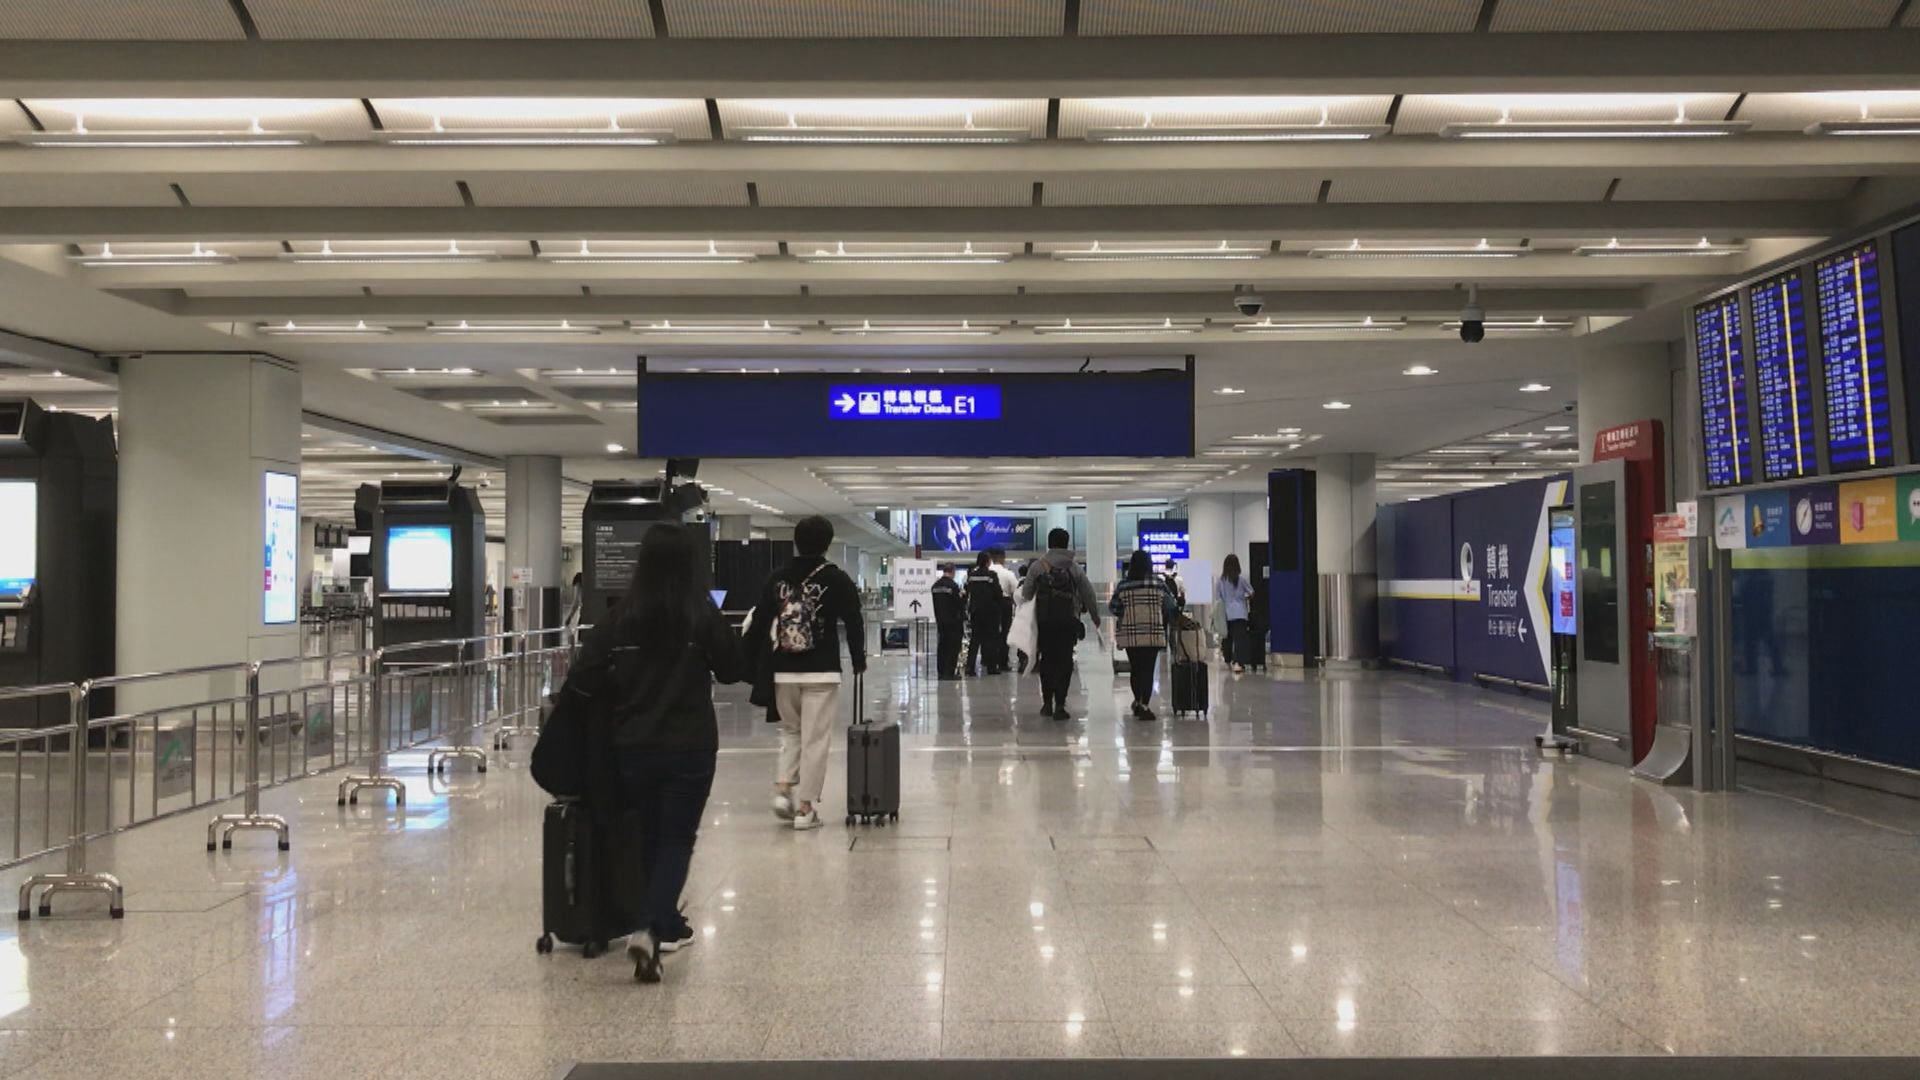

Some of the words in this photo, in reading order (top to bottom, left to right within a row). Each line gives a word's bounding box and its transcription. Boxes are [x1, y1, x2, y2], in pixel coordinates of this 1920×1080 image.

[883, 404, 922, 414] Transfer
[923, 404, 953, 414] Desks
[954, 396, 975, 414] E1
[1486, 584, 1518, 607] Transfer
